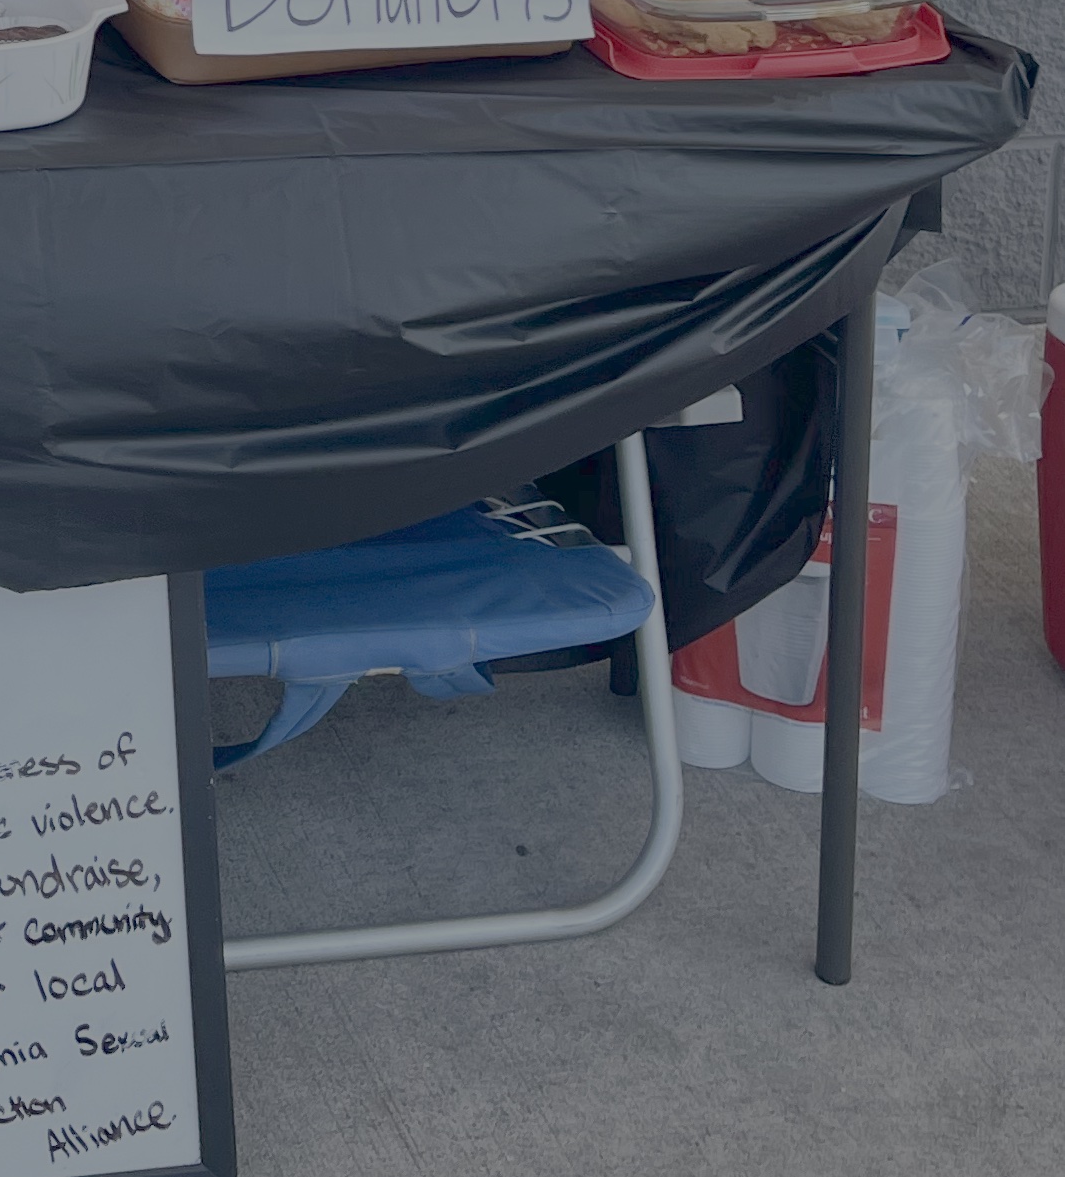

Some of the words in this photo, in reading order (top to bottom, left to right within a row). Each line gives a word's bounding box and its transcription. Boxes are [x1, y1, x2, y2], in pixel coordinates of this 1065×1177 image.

[97, 731, 137, 770] of
[31, 791, 175, 837] violence.
[34, 958, 127, 1003] local
[46, 1100, 178, 1163] Alliance.
